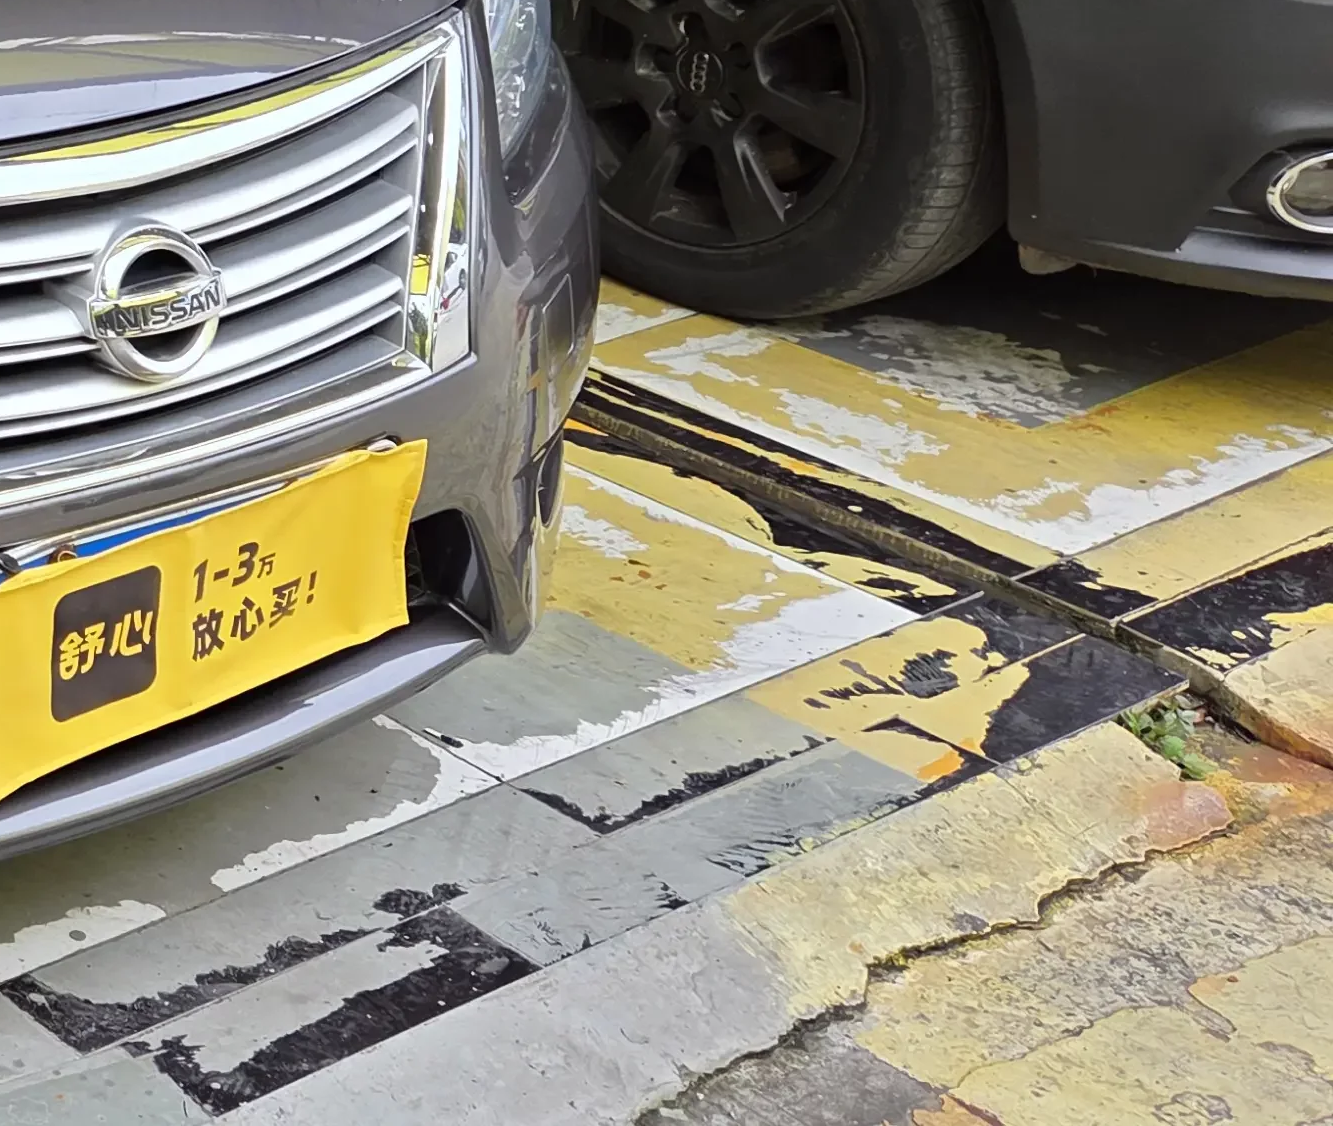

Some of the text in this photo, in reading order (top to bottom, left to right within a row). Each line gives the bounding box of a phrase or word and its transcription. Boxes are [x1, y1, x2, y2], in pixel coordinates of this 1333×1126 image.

[112, 281, 221, 336] NISSAN
[193, 541, 277, 603] 1-3万
[59, 608, 155, 680] 舒心
[191, 571, 320, 662] 放心买!
